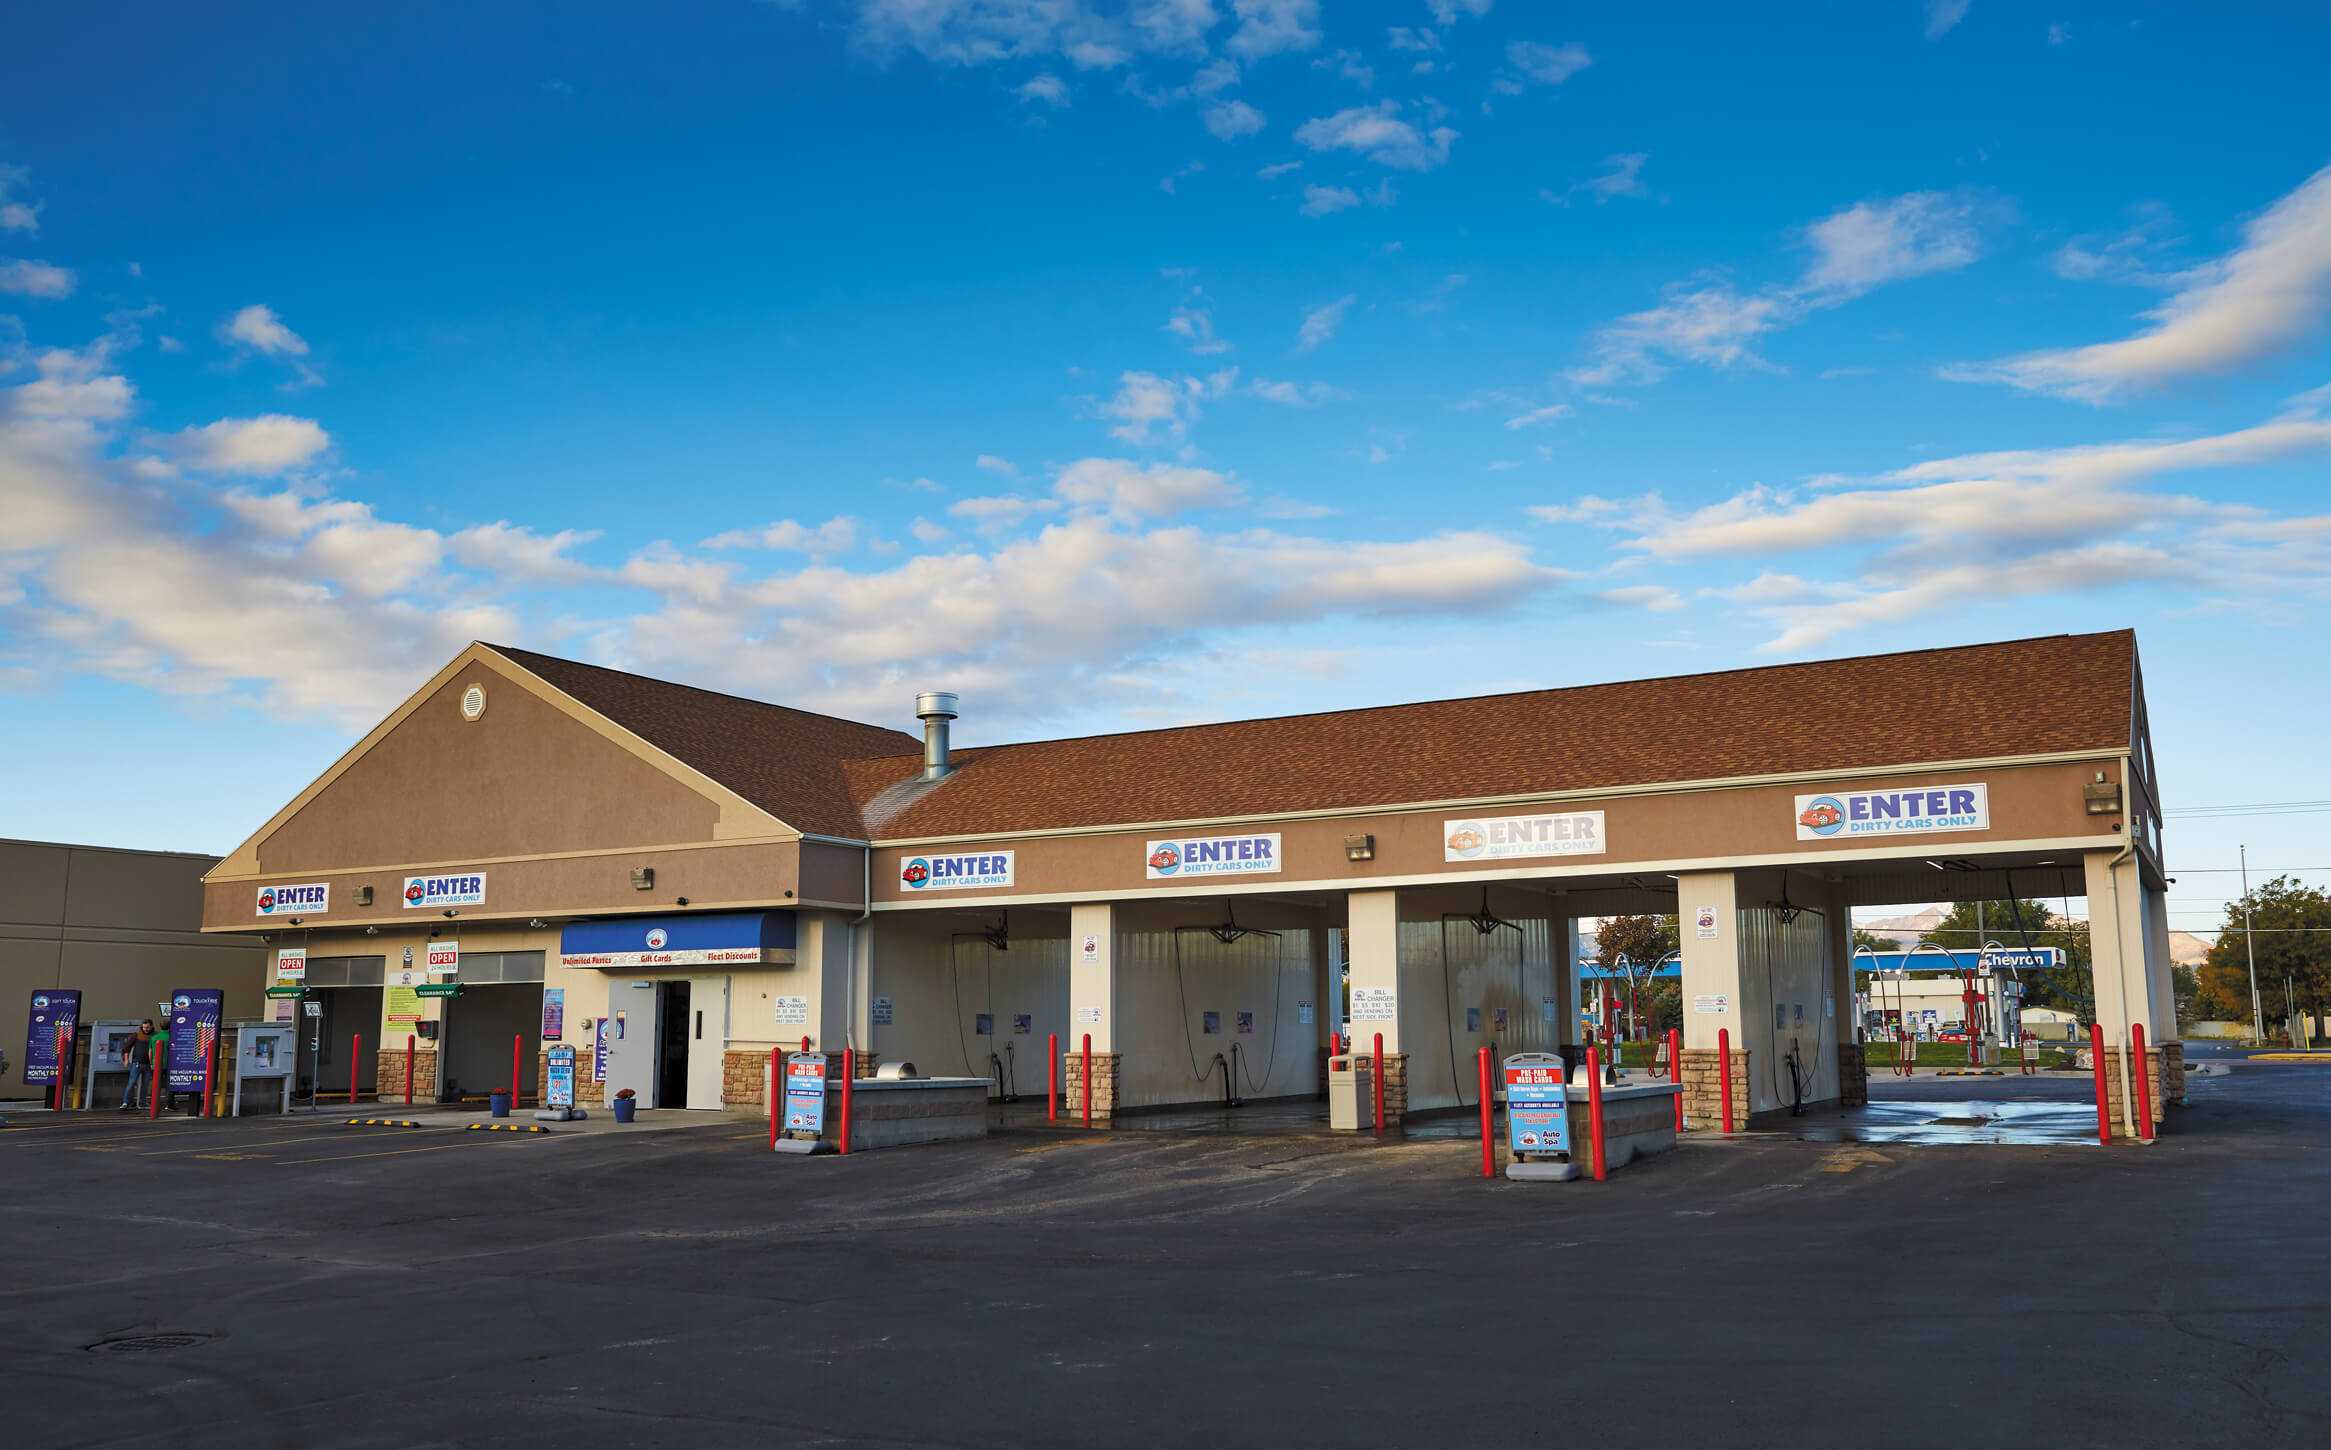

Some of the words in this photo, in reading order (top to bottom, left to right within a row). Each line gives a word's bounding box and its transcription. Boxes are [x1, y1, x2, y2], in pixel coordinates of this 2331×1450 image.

[1849, 790, 1976, 820] ENTER
[1490, 817, 1595, 844] ENTER
[1850, 820, 1891, 831] DIRTY
[1896, 818, 1932, 829] CARS
[1937, 816, 1976, 826] ONLY
[1184, 839, 1272, 862] ENTER
[1490, 845, 1524, 854] DIRTY
[1528, 842, 1558, 852] CARS
[1562, 840, 1595, 850] ONLY
[932, 856, 1007, 877] ENTER
[1184, 864, 1213, 872] DIRTY
[1216, 862, 1241, 870] CARS
[1244, 860, 1272, 869] ONLY
[427, 877, 480, 896] ENTER
[278, 887, 324, 904] ENTER
[281, 960, 301, 968] OPEN
[431, 954, 454, 963] OPEN
[563, 957, 590, 965] Unlimited
[708, 953, 724, 961] Fleet
[726, 952, 757, 960] Discounts
